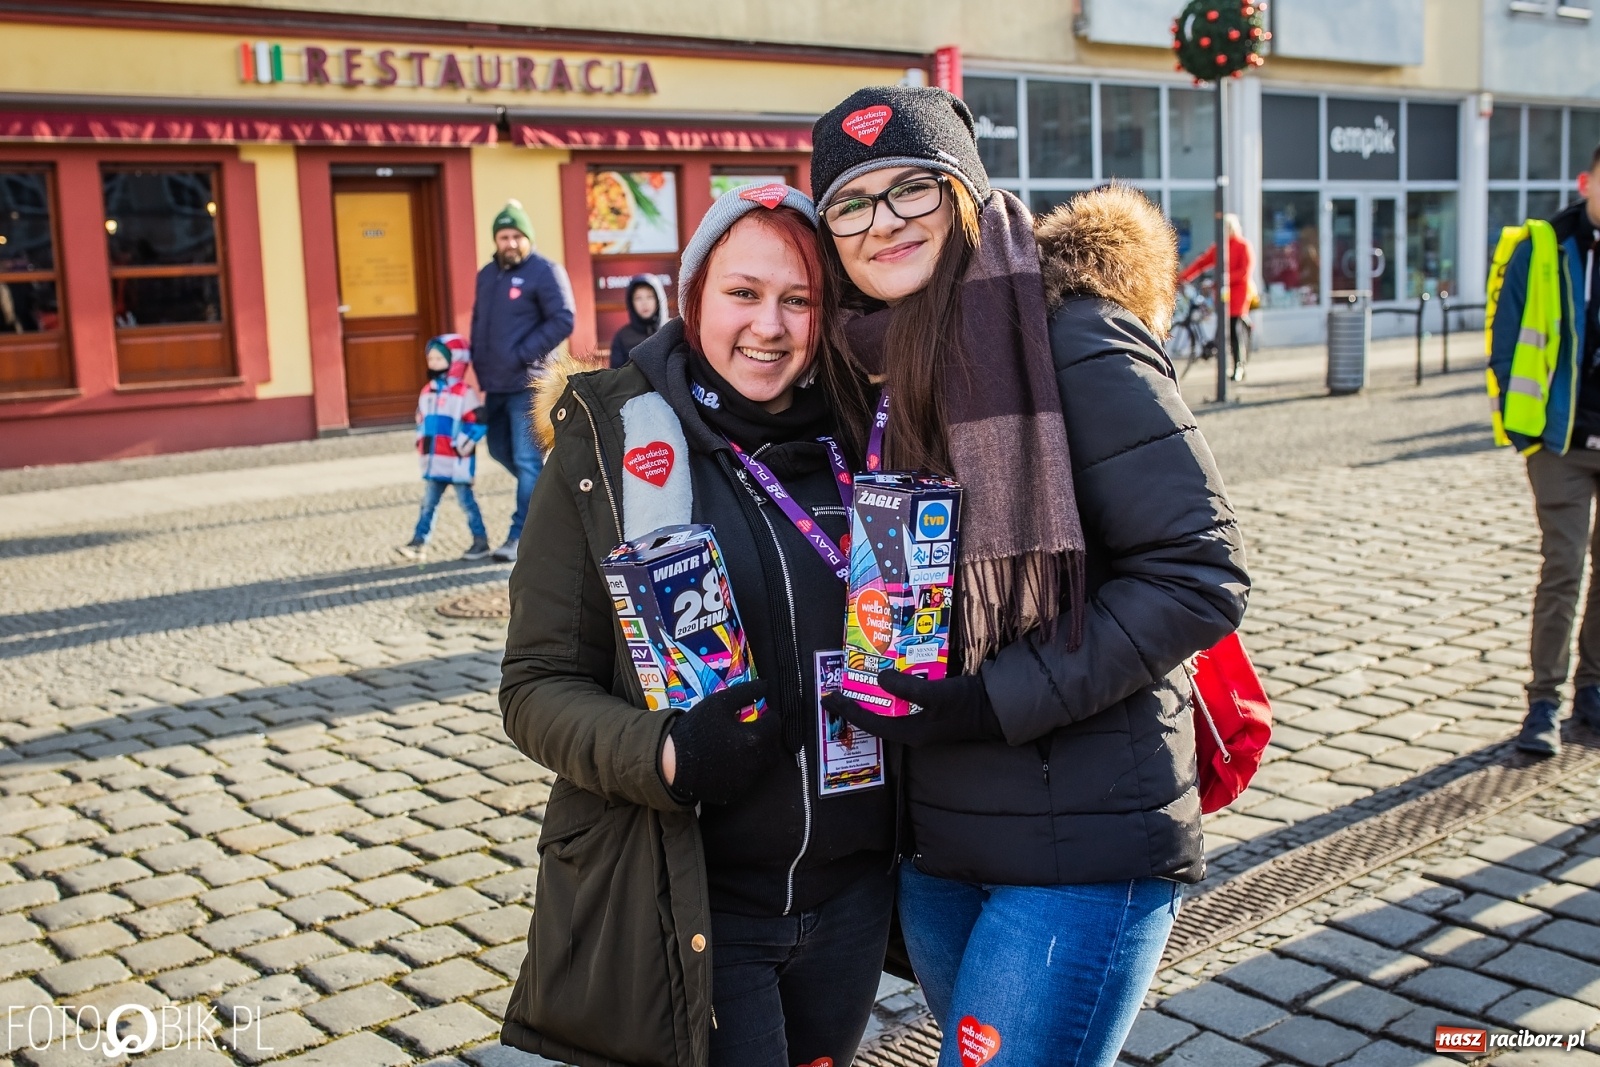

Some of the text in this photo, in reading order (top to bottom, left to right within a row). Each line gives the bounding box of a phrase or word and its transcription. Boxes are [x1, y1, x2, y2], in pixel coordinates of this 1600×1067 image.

[304, 46, 658, 94] RESTAURACJA
[1330, 115, 1396, 160] empik
[628, 448, 669, 466] wielka orkiestra
[828, 441, 844, 470] PLAY
[645, 467, 666, 479] pomocy
[741, 453, 787, 499] 28 PLAY
[858, 490, 902, 510] ŻAGLE
[923, 514, 945, 527] tvn
[811, 534, 840, 565] PLAY
[653, 554, 700, 583] WIATR
[913, 571, 945, 583] player
[673, 567, 724, 640] 28
[862, 599, 883, 614] wielka
[677, 622, 697, 637] 2020
[843, 689, 892, 707] ZABIEGOWEJ
